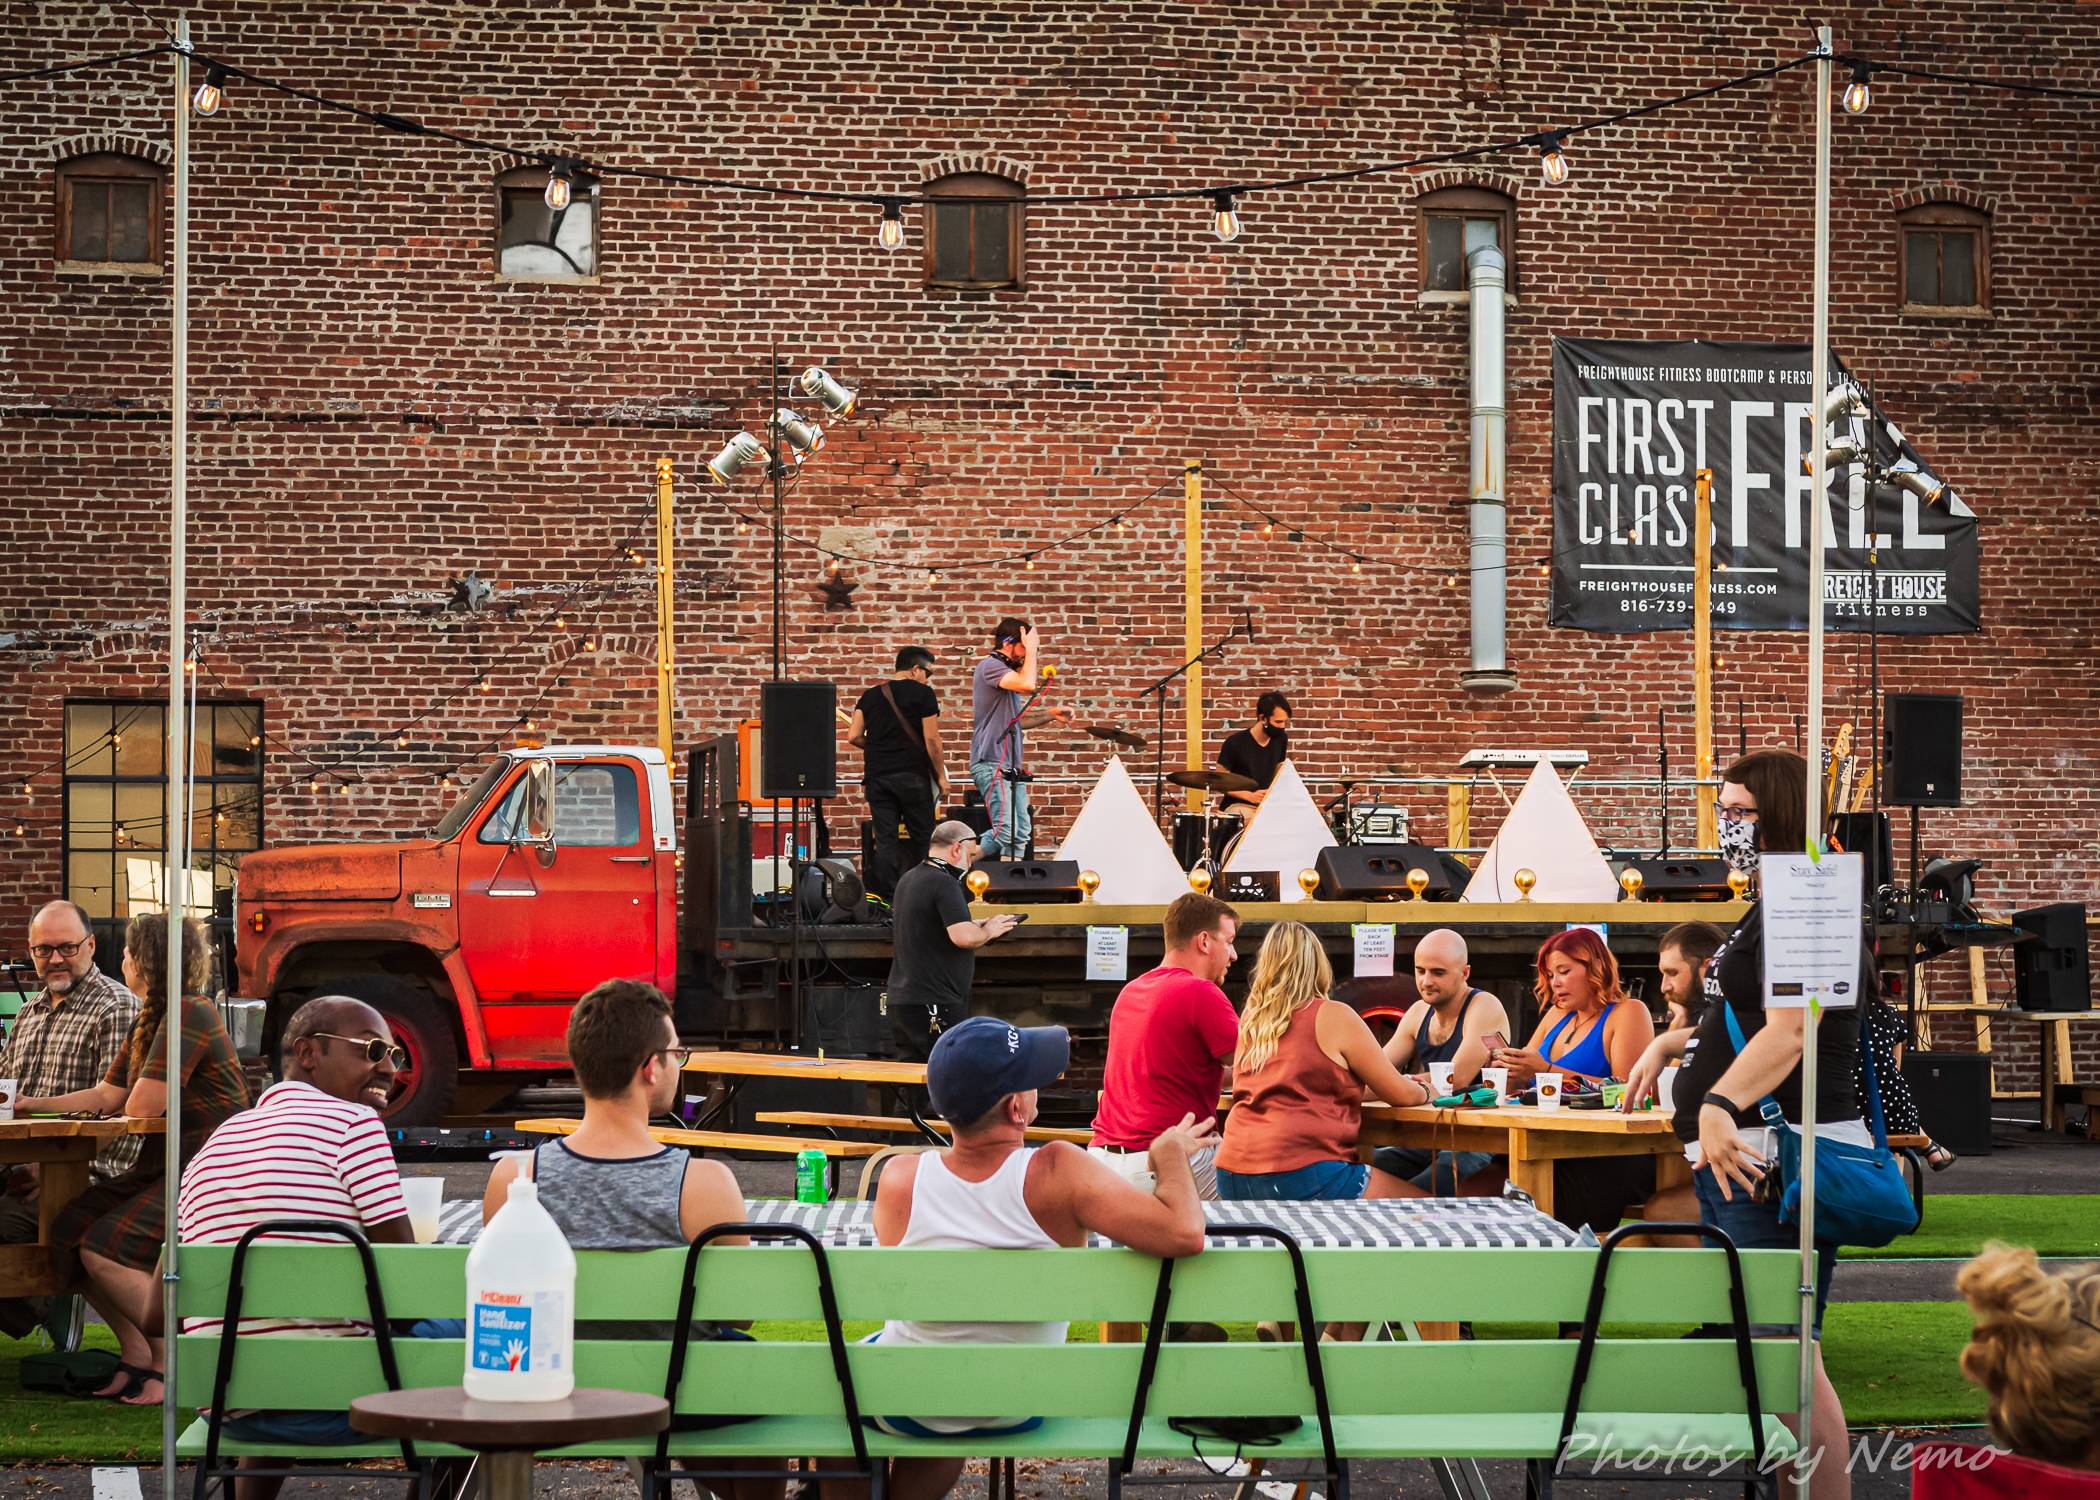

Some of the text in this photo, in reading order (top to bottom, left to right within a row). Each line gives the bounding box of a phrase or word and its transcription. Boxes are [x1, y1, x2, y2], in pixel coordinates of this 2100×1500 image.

[1578, 365, 1655, 381] FREIGHTHOUSE
[1659, 367, 1702, 382] FITNESS
[1706, 368, 1764, 383] BOOTCAMP
[1768, 371, 1776, 384] &
[1780, 371, 1833, 385] PERSOL
[1578, 396, 1714, 477] FIRST
[1579, 580, 1777, 596] FREIGHTHOUSEFNESS.COM
[1823, 575, 1947, 599] REIGHT HOUSE
[1835, 602, 1928, 616] fitness
[1790, 864, 1812, 878] Stay
[480, 1308, 506, 1319] Hand
[479, 1317, 527, 1330] Sanitizer
